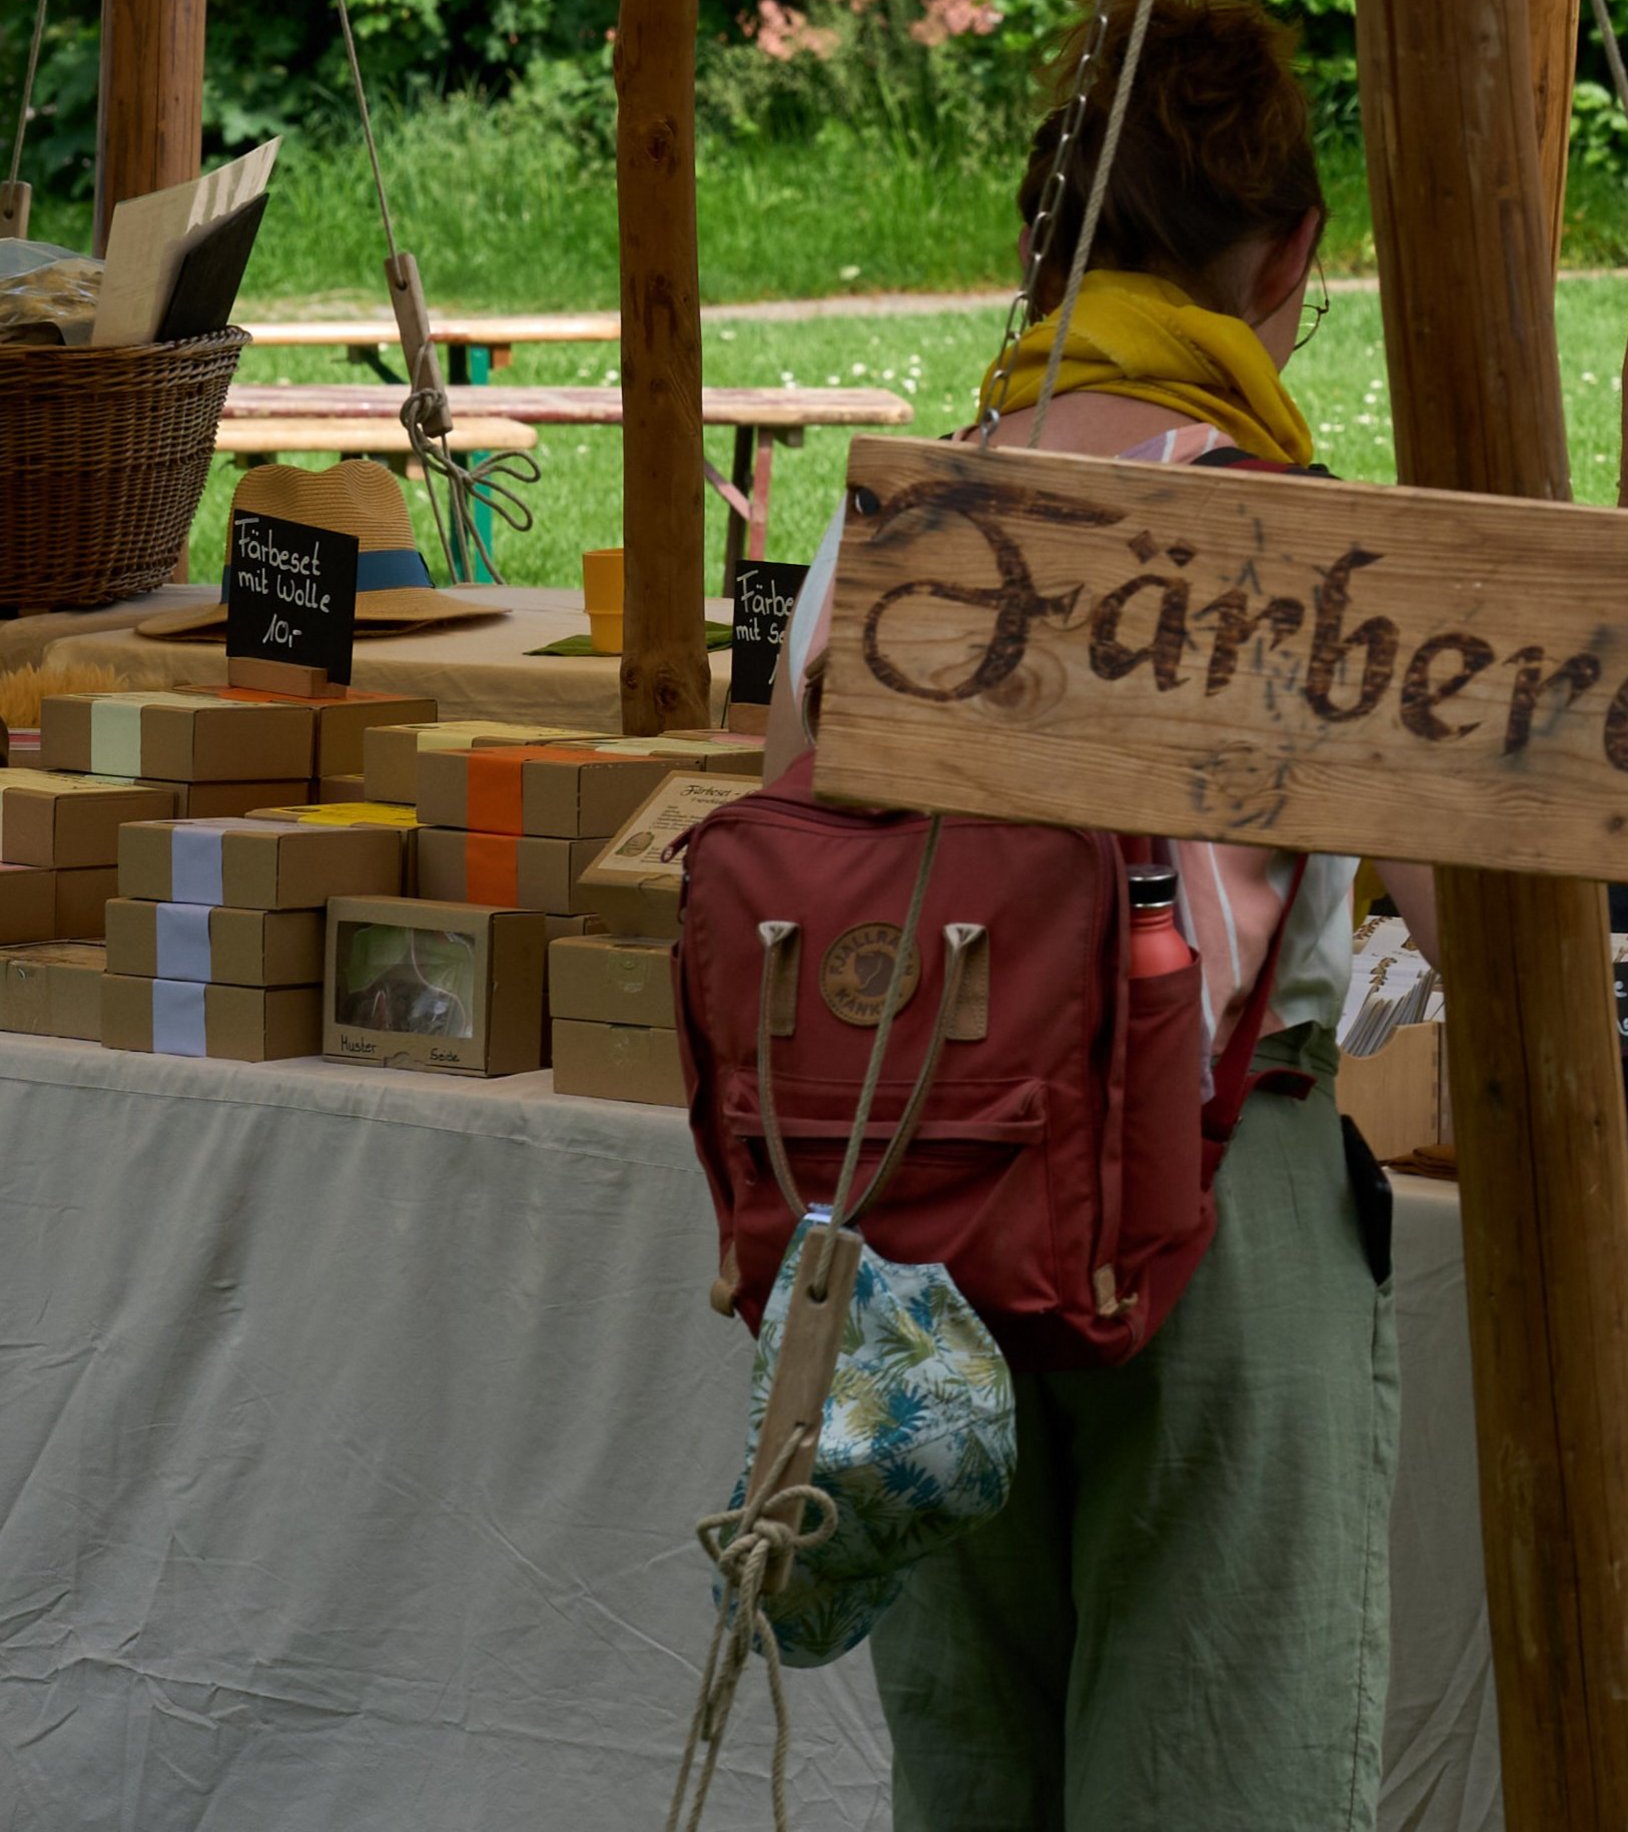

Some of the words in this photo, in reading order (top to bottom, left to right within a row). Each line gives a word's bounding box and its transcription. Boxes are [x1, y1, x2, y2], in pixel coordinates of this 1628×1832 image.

[234, 517, 321, 576] Färbeset
[238, 568, 269, 595] mit
[276, 574, 331, 613] Wolle
[736, 569, 794, 617] Färbe
[736, 617, 761, 642] mit
